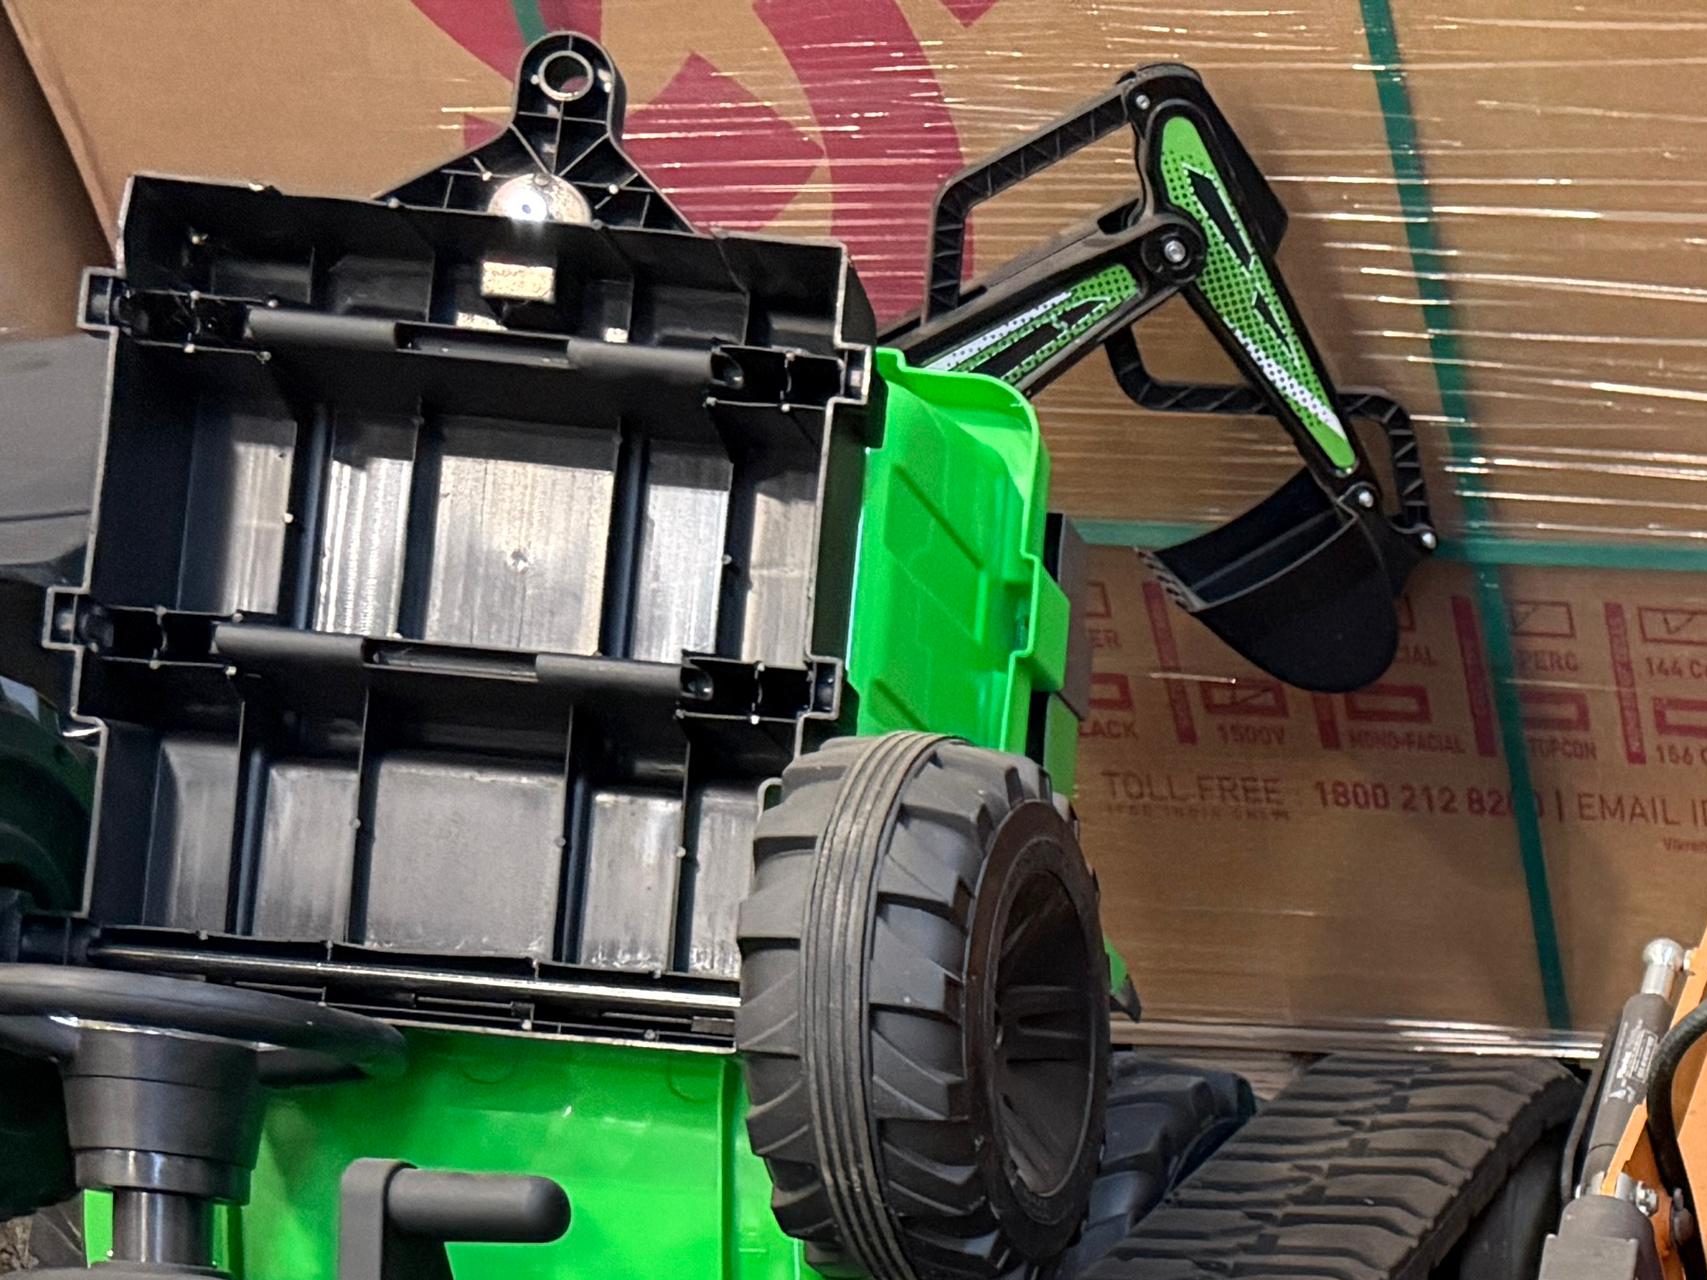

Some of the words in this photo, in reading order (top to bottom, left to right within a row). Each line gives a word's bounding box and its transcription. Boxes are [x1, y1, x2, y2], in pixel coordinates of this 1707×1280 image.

[1646, 656, 1684, 679] 144
[1079, 717, 1138, 740] LACK
[1655, 744, 1695, 767] 156
[1101, 770, 1188, 801] TOLL
[1198, 775, 1285, 807] FREE
[1314, 780, 1390, 811] 1800
[1401, 784, 1460, 813] 212
[1577, 792, 1684, 827] EMAIL
